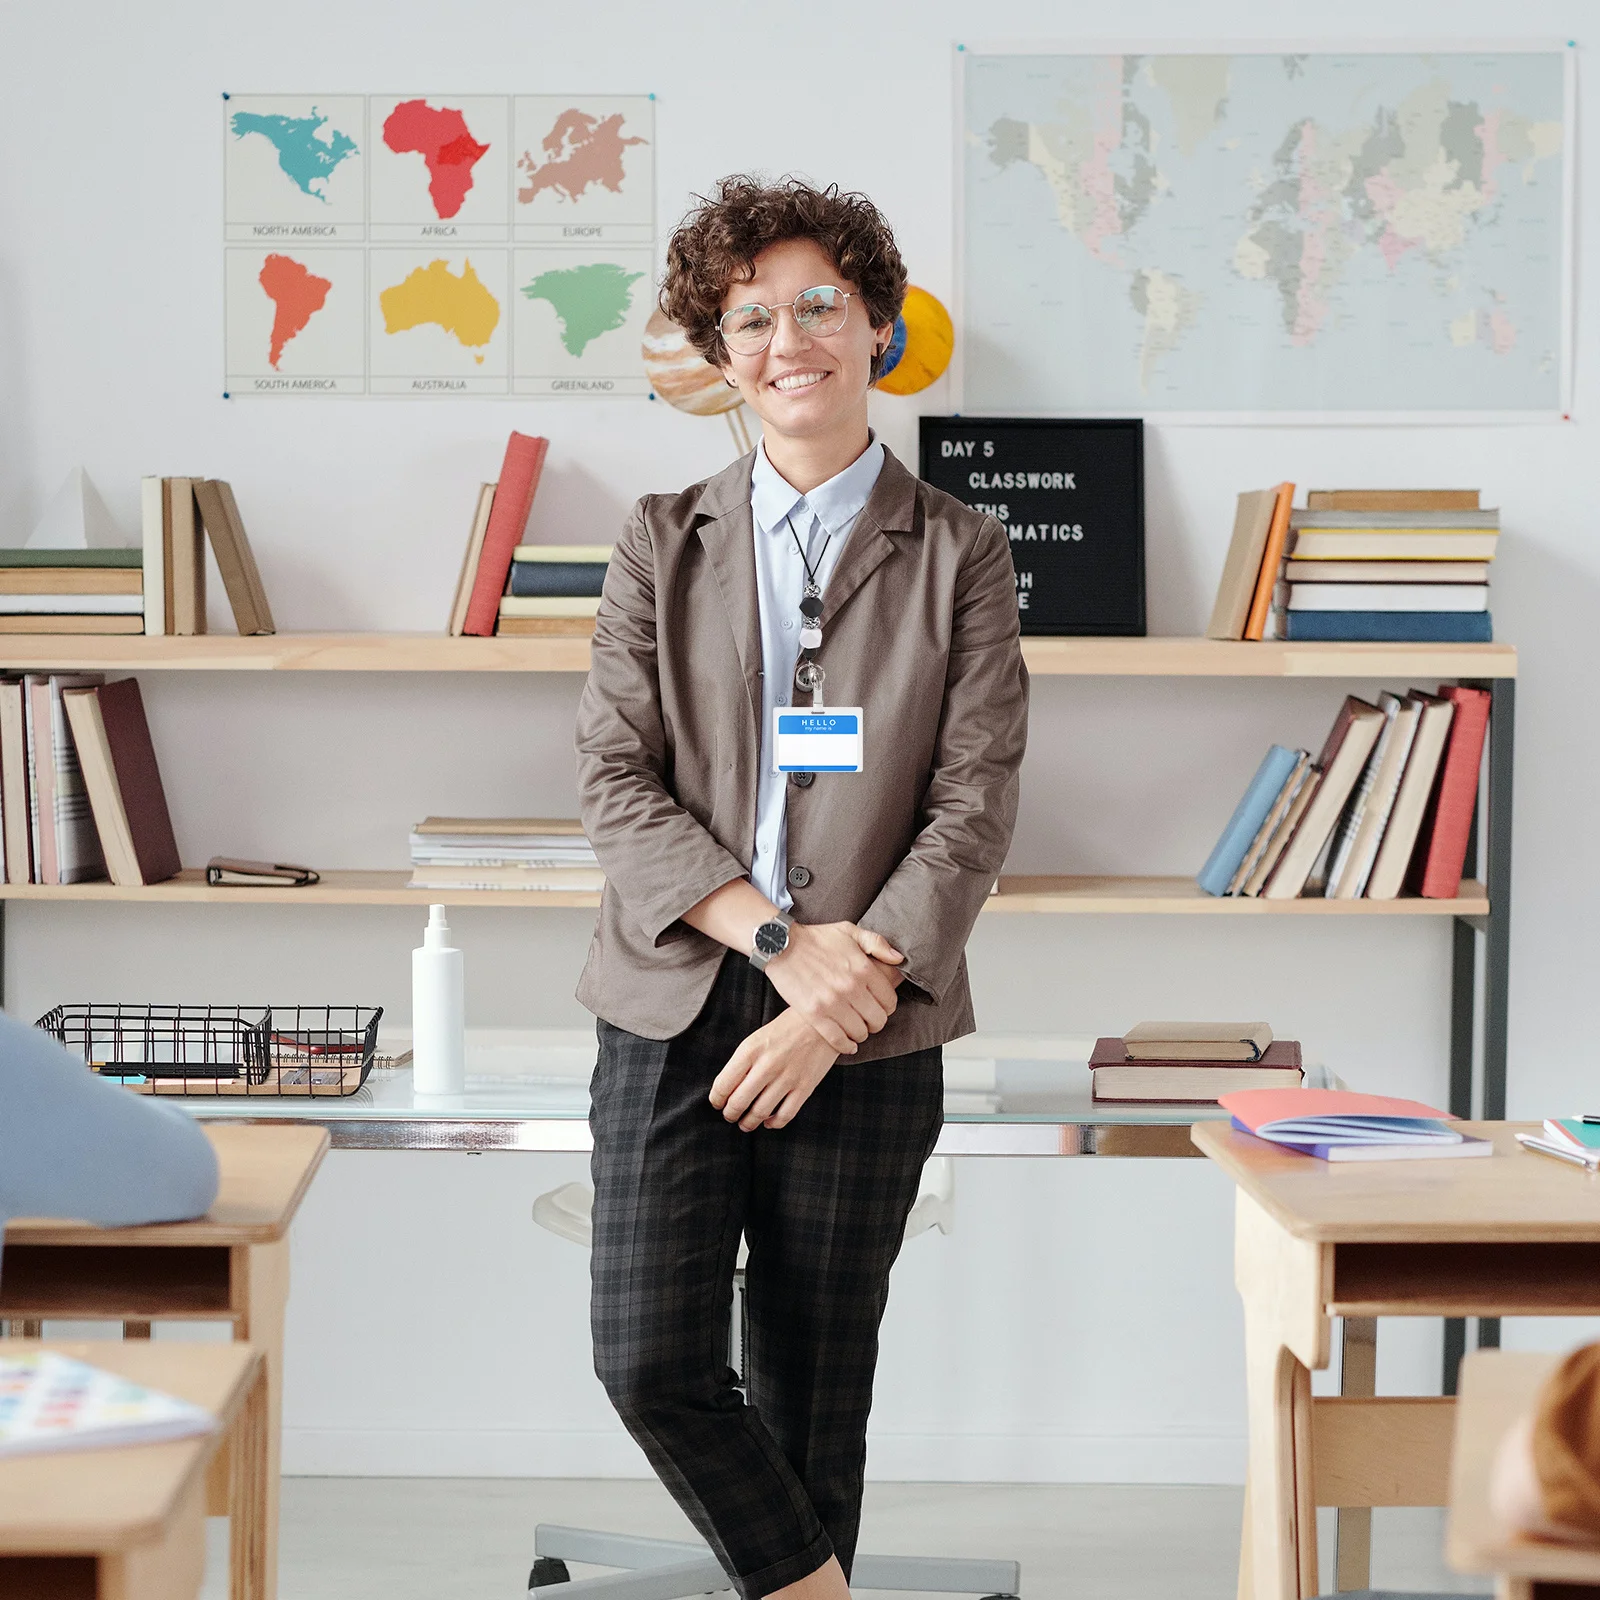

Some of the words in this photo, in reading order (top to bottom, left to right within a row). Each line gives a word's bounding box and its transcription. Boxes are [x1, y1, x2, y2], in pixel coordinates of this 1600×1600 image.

[253, 225, 289, 236] NORTH
[291, 226, 337, 236] AMERICA
[421, 226, 457, 236] AFRICA
[563, 226, 602, 237] EUROPE
[254, 380, 289, 390] SOUTH
[291, 380, 337, 390] AMERICA
[411, 380, 467, 390] AUSTRALIA
[551, 380, 614, 390] GREENLAND
[941, 440, 975, 458] DAY
[983, 440, 995, 458] 5
[968, 472, 1076, 490] CLASSWORK
[967, 503, 1010, 521] THS
[1003, 523, 1084, 542] MATICS
